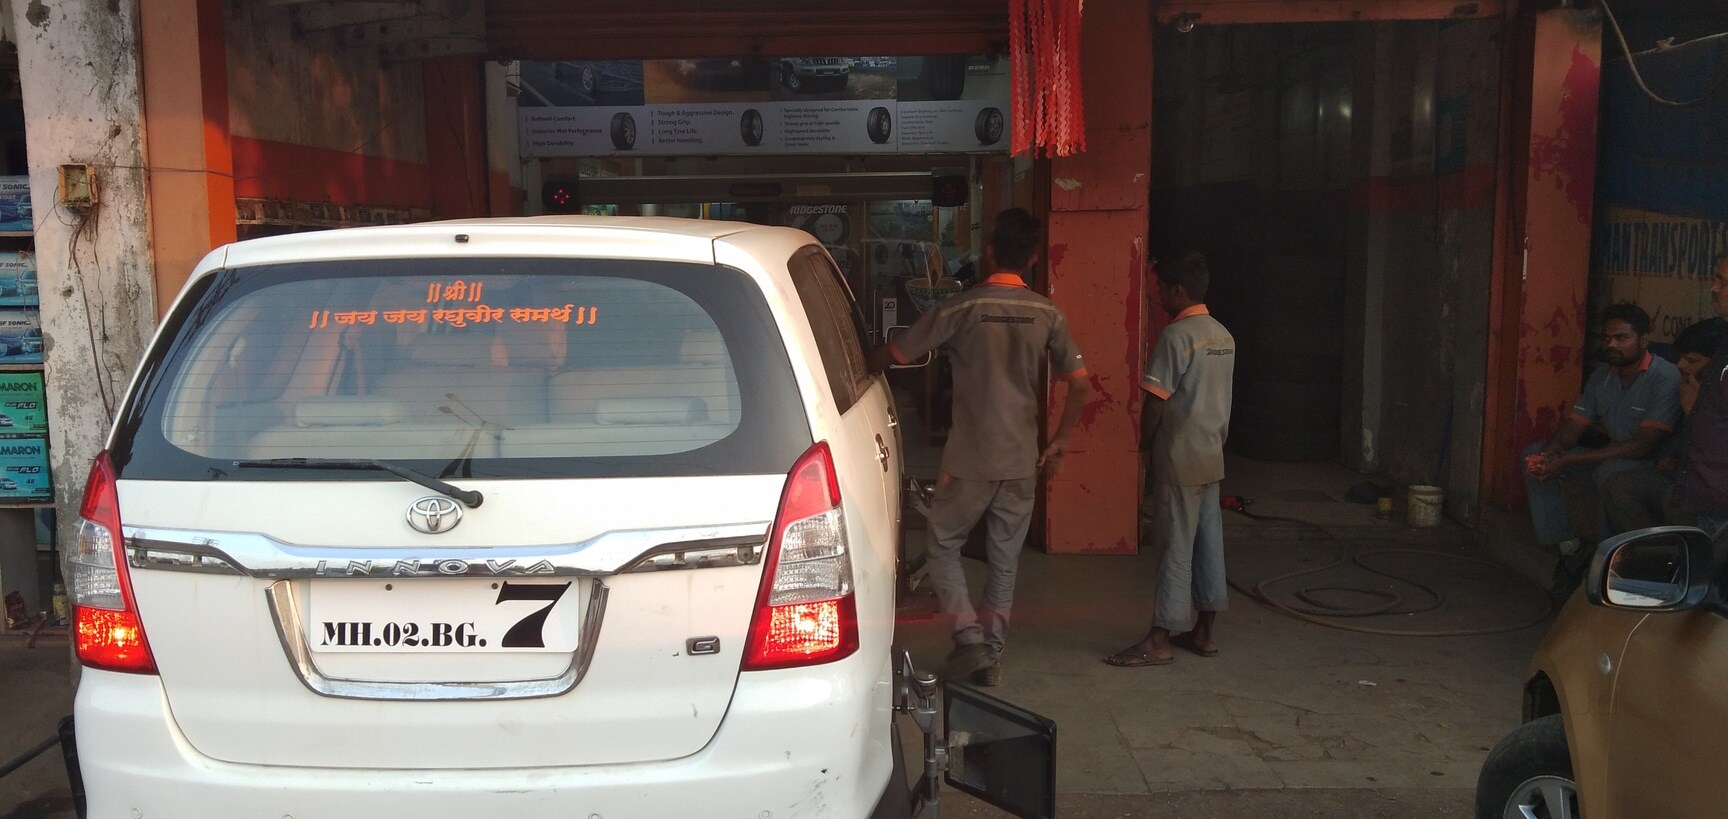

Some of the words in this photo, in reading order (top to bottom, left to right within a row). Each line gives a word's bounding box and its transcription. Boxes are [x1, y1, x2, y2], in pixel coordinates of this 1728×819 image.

[334, 310, 379, 326] जय
[383, 308, 427, 325] जय
[432, 304, 505, 328] रघुवीर
[510, 303, 575, 324] समर्थ
[315, 559, 557, 576] INNOVA
[495, 580, 573, 648] 7
